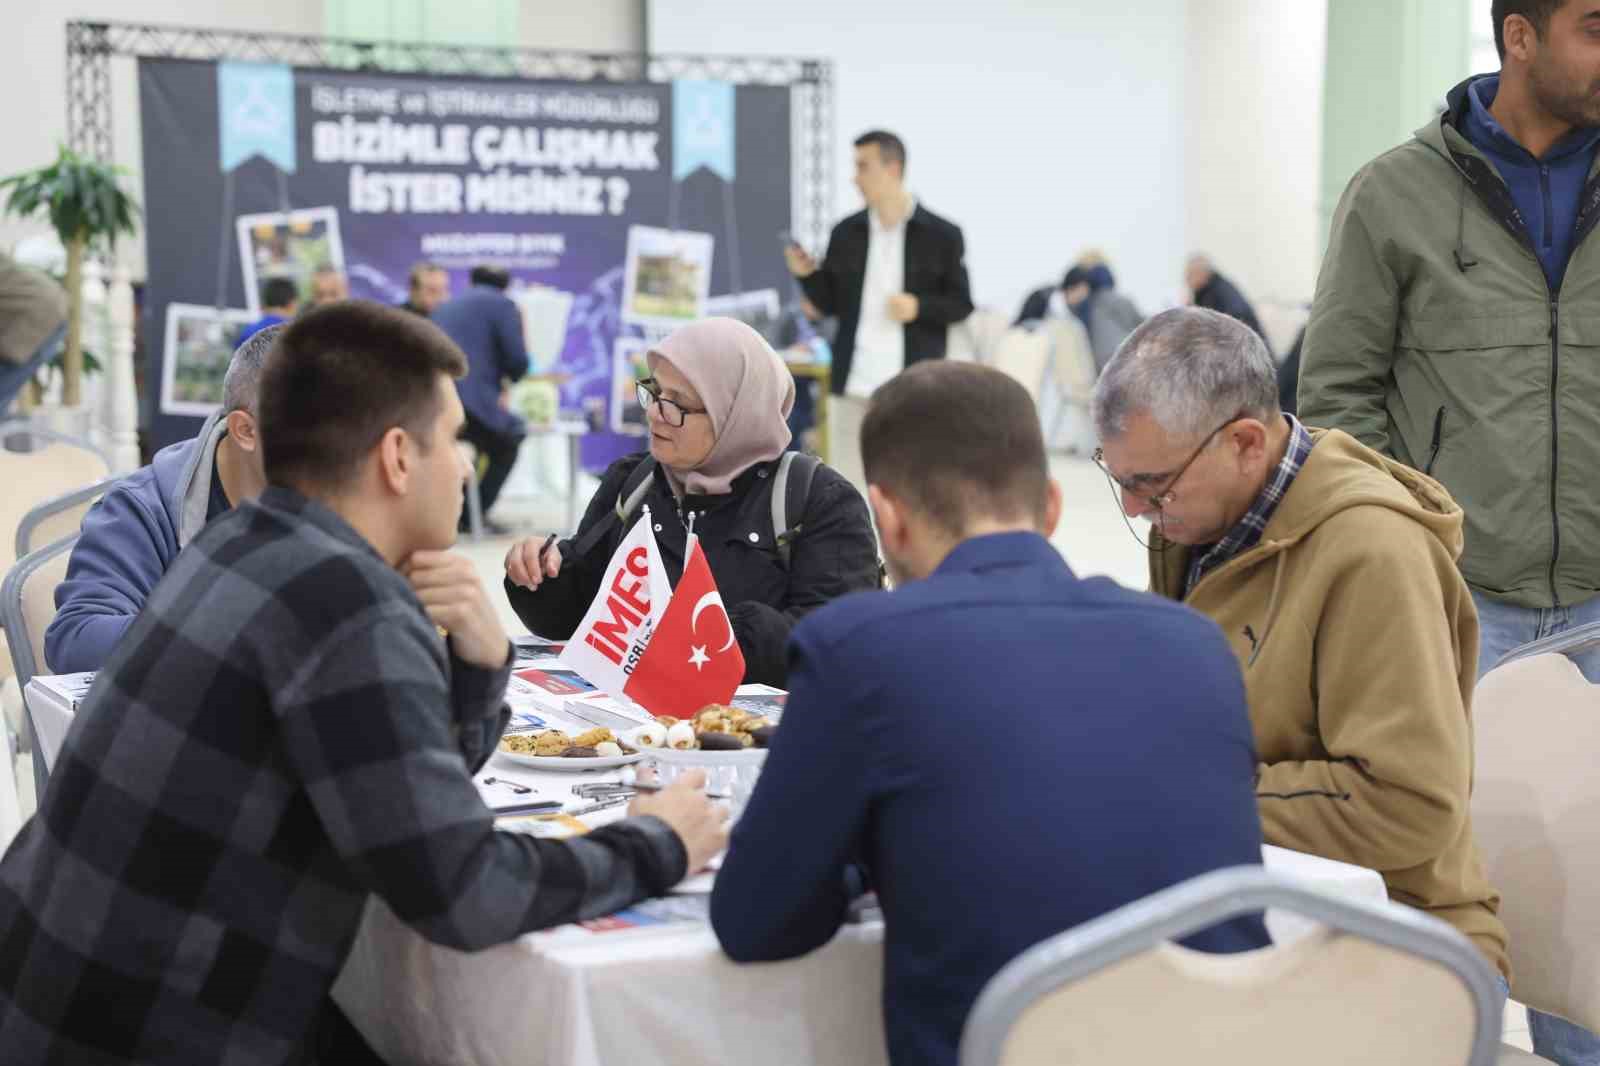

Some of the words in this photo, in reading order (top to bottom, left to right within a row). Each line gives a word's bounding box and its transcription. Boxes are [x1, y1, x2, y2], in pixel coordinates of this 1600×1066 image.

[313, 116, 470, 164] BİZİMLE
[473, 126, 660, 173] ÇALIŞMAK
[349, 164, 462, 213] İSTER
[466, 168, 602, 215] MİSİNİZ
